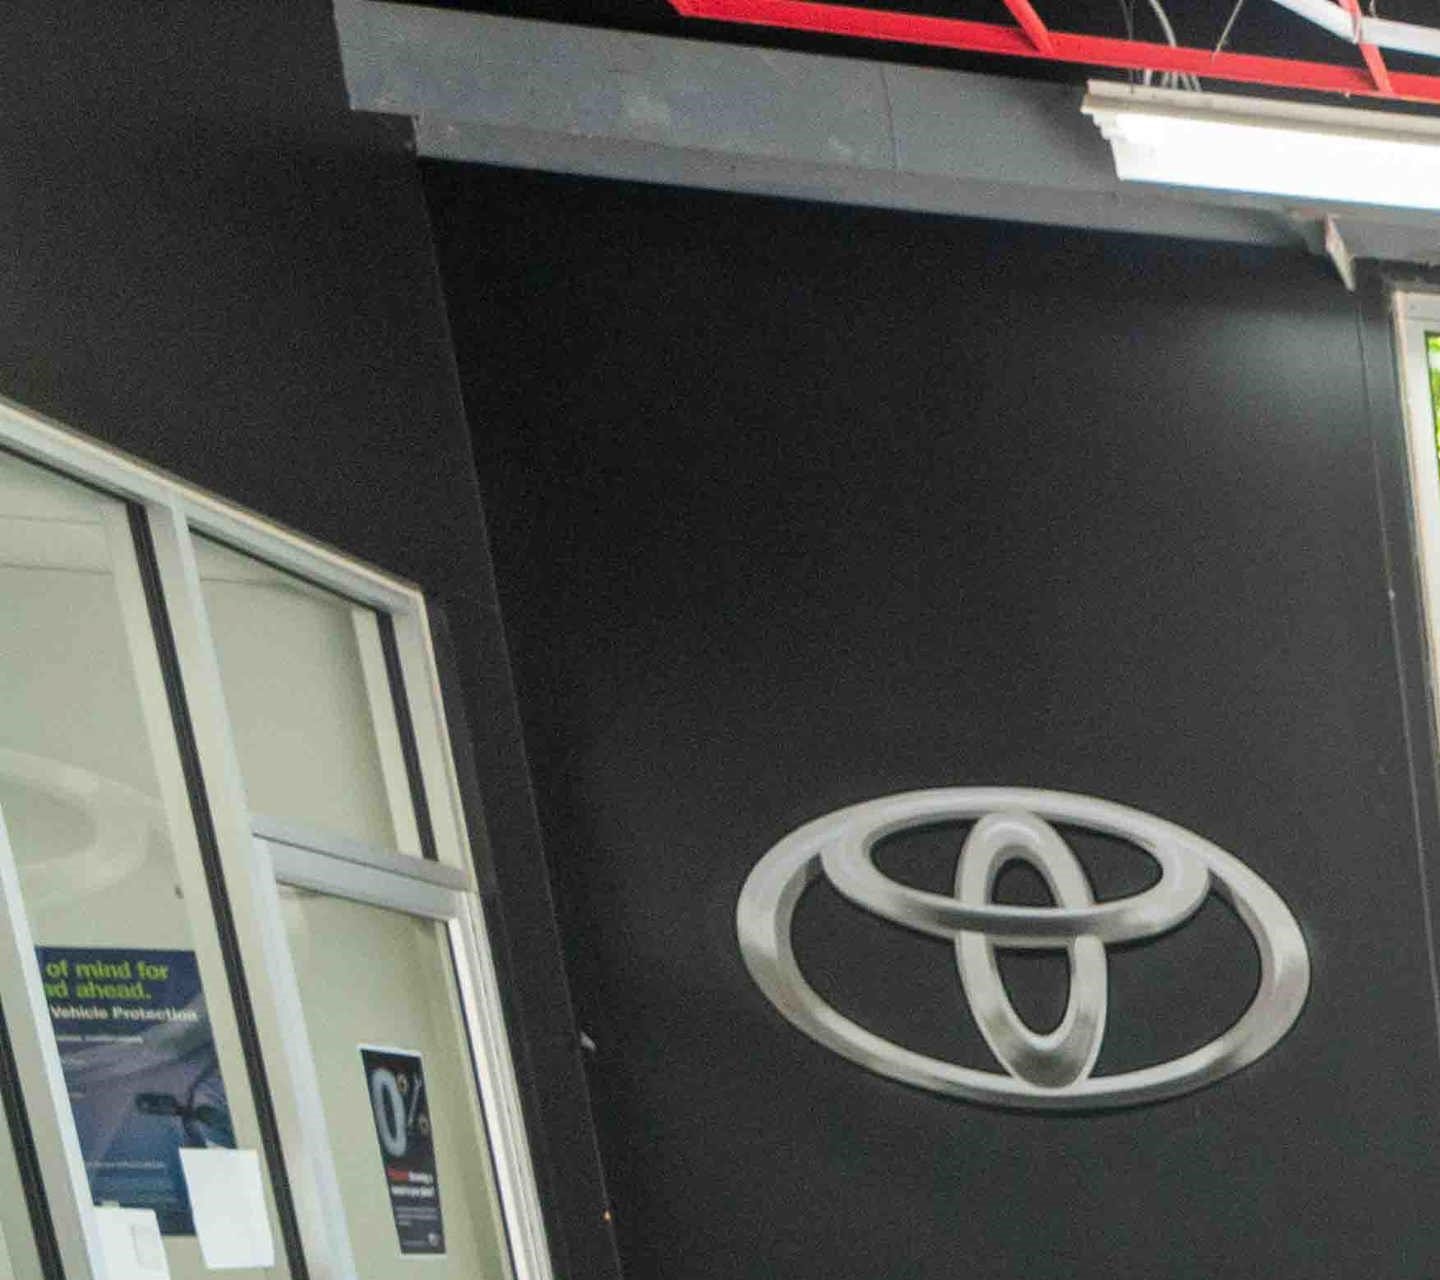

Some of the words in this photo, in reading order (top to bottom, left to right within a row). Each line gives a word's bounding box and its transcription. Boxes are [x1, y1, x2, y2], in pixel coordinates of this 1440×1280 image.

[46, 960, 68, 978] of
[76, 960, 132, 978] mind
[137, 961, 168, 980] for
[76, 981, 151, 999] ahead.
[51, 1005, 108, 1019] Vehicle
[112, 1006, 197, 1021] Protection
